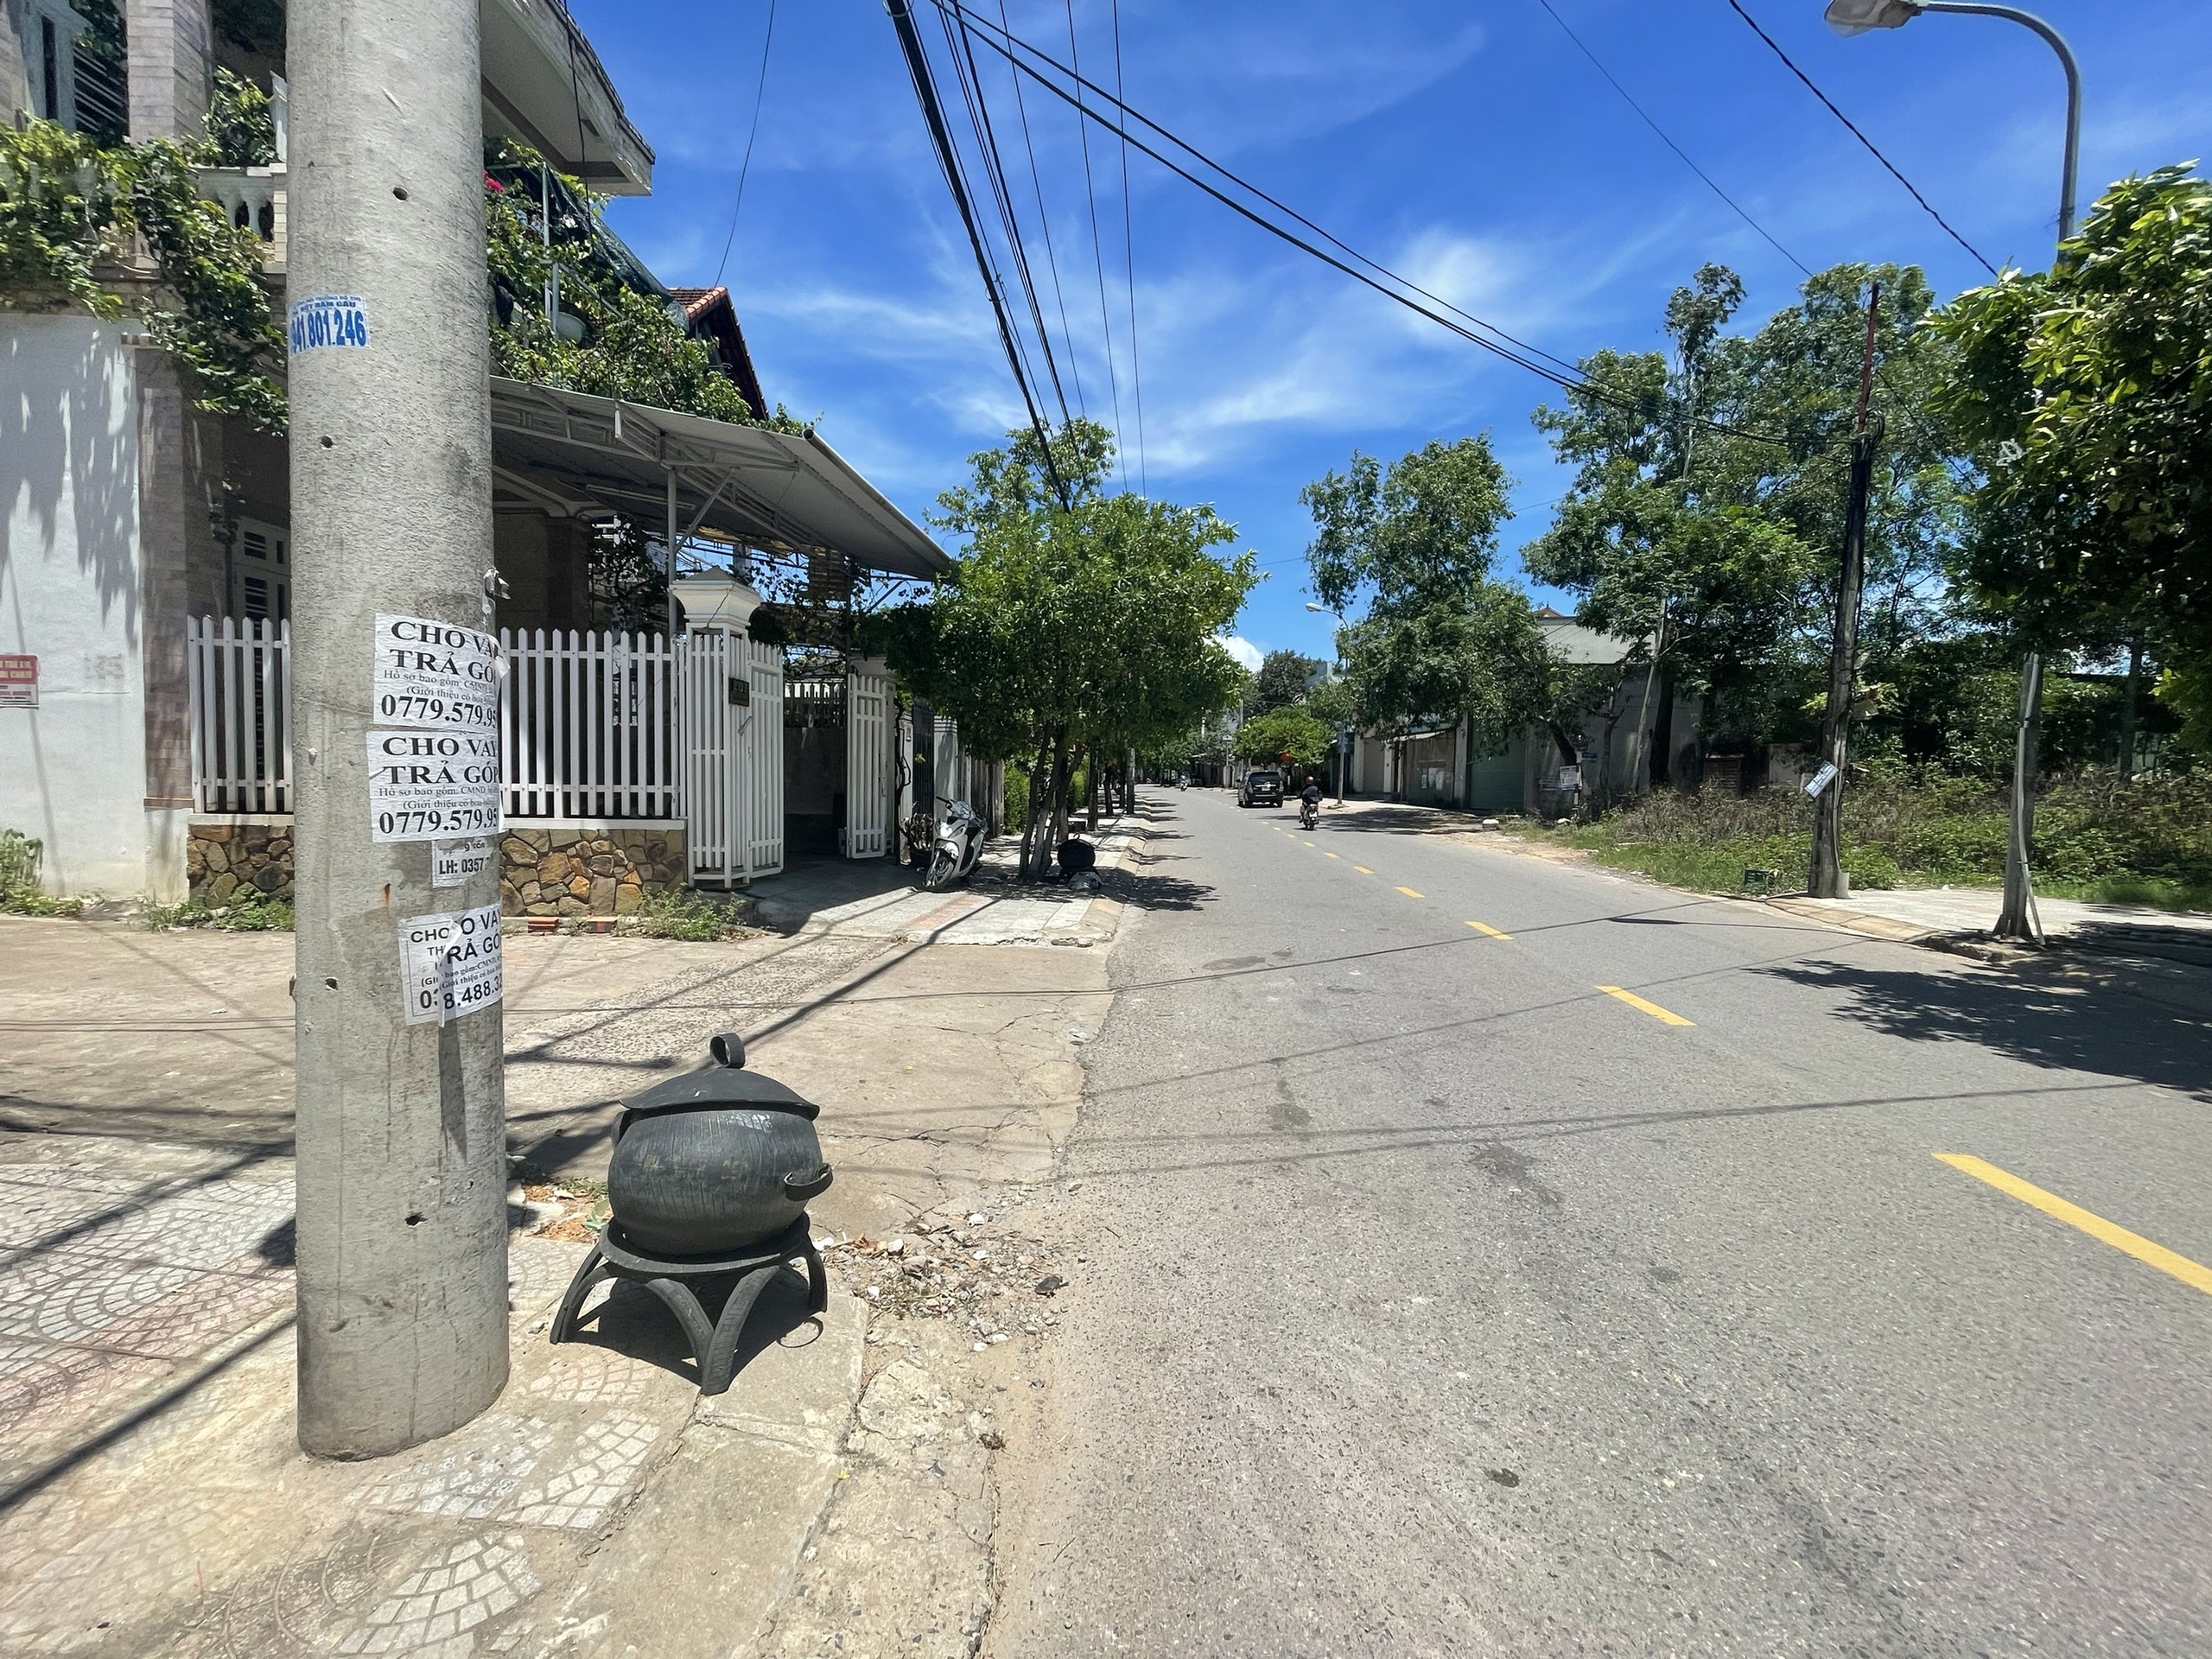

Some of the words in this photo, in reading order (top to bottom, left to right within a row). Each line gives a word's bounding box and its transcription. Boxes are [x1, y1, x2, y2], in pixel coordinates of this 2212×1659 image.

[391, 621, 466, 648] CHO
[390, 649, 460, 676] TRẢ
[419, 674, 437, 683] bao
[382, 737, 460, 756] CHO
[383, 760, 456, 784] TRẢ
[415, 787, 432, 796] bao
[435, 799, 456, 809] thiệu
[439, 859, 458, 874] LH:
[461, 857, 489, 873] 0357
[410, 927, 450, 943] CHO
[446, 938, 478, 964] RẢ
[483, 929, 500, 954] GÓ
